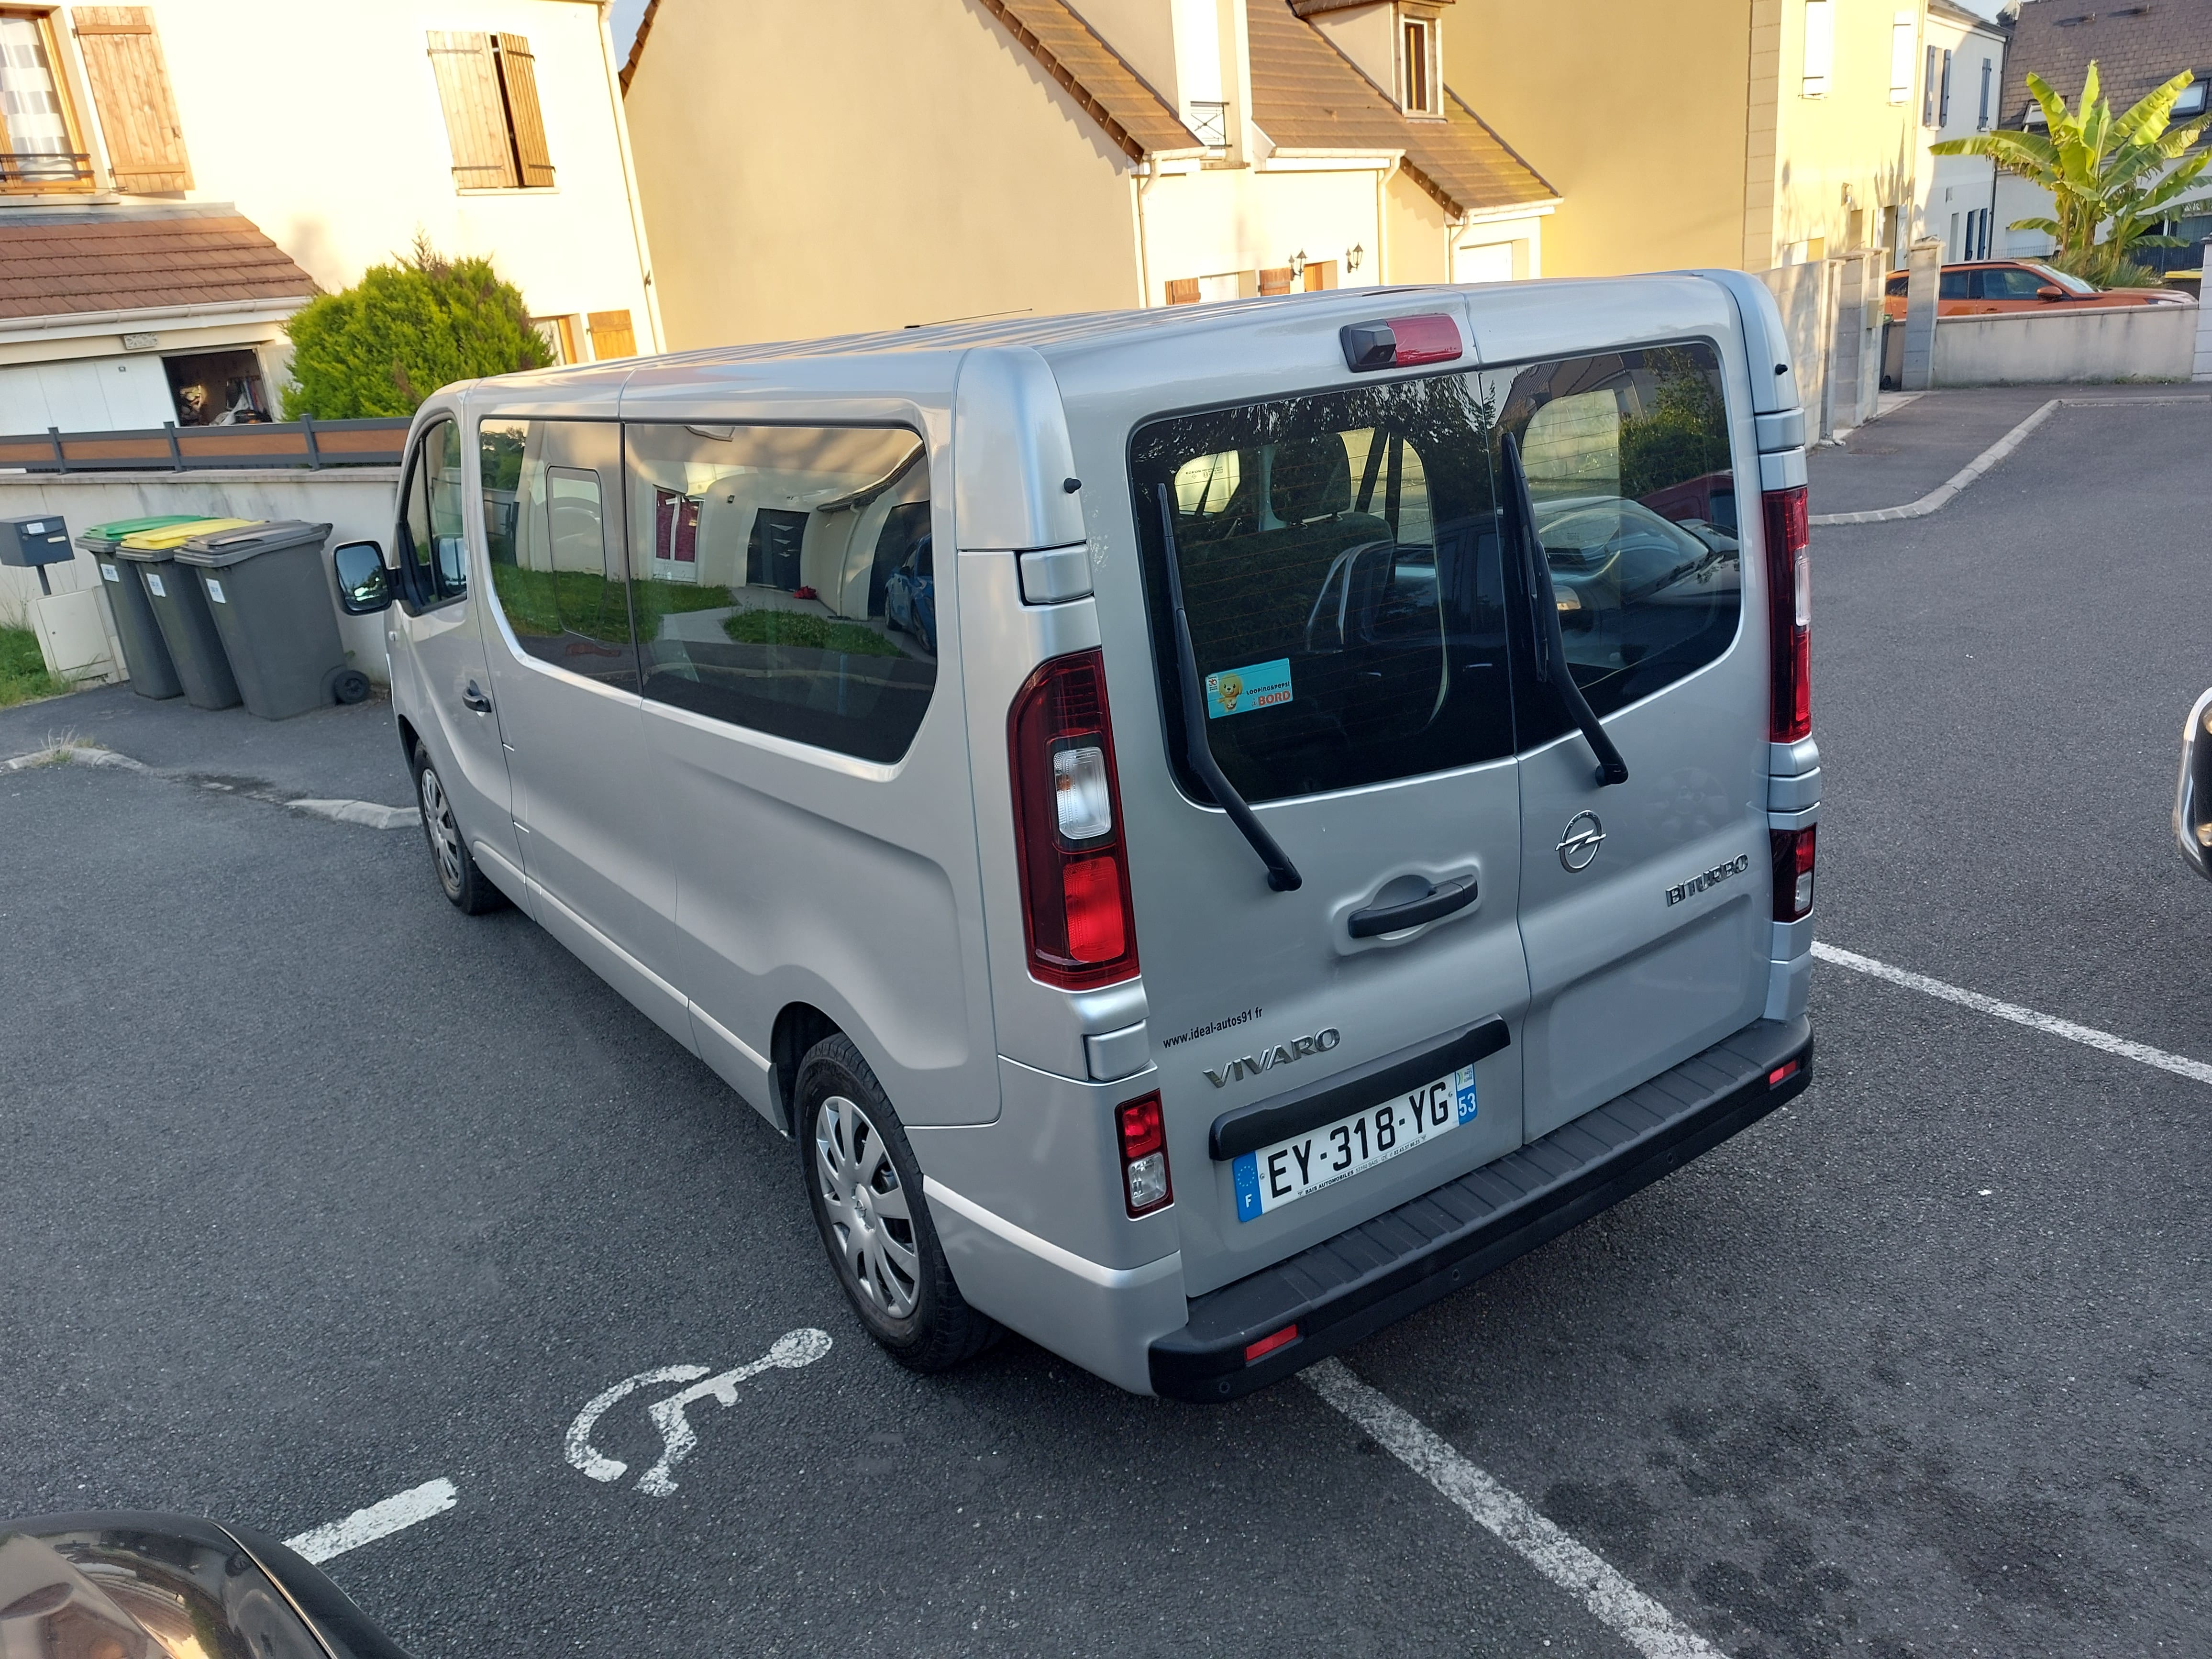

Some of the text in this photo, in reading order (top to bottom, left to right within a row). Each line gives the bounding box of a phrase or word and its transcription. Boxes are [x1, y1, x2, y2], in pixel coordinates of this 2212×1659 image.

[1258, 691, 1291, 706] BORD
[1665, 853, 1748, 907] BITURBO
[1202, 1027, 1340, 1088] VIVARO
[1458, 1093, 1476, 1117] 53
[1267, 1081, 1449, 1199] EY-318-YG
[1305, 1186, 1317, 1194] BAIS
[1318, 1170, 1354, 1189] AUTOMOBILES
[1245, 1194, 1252, 1208] F
